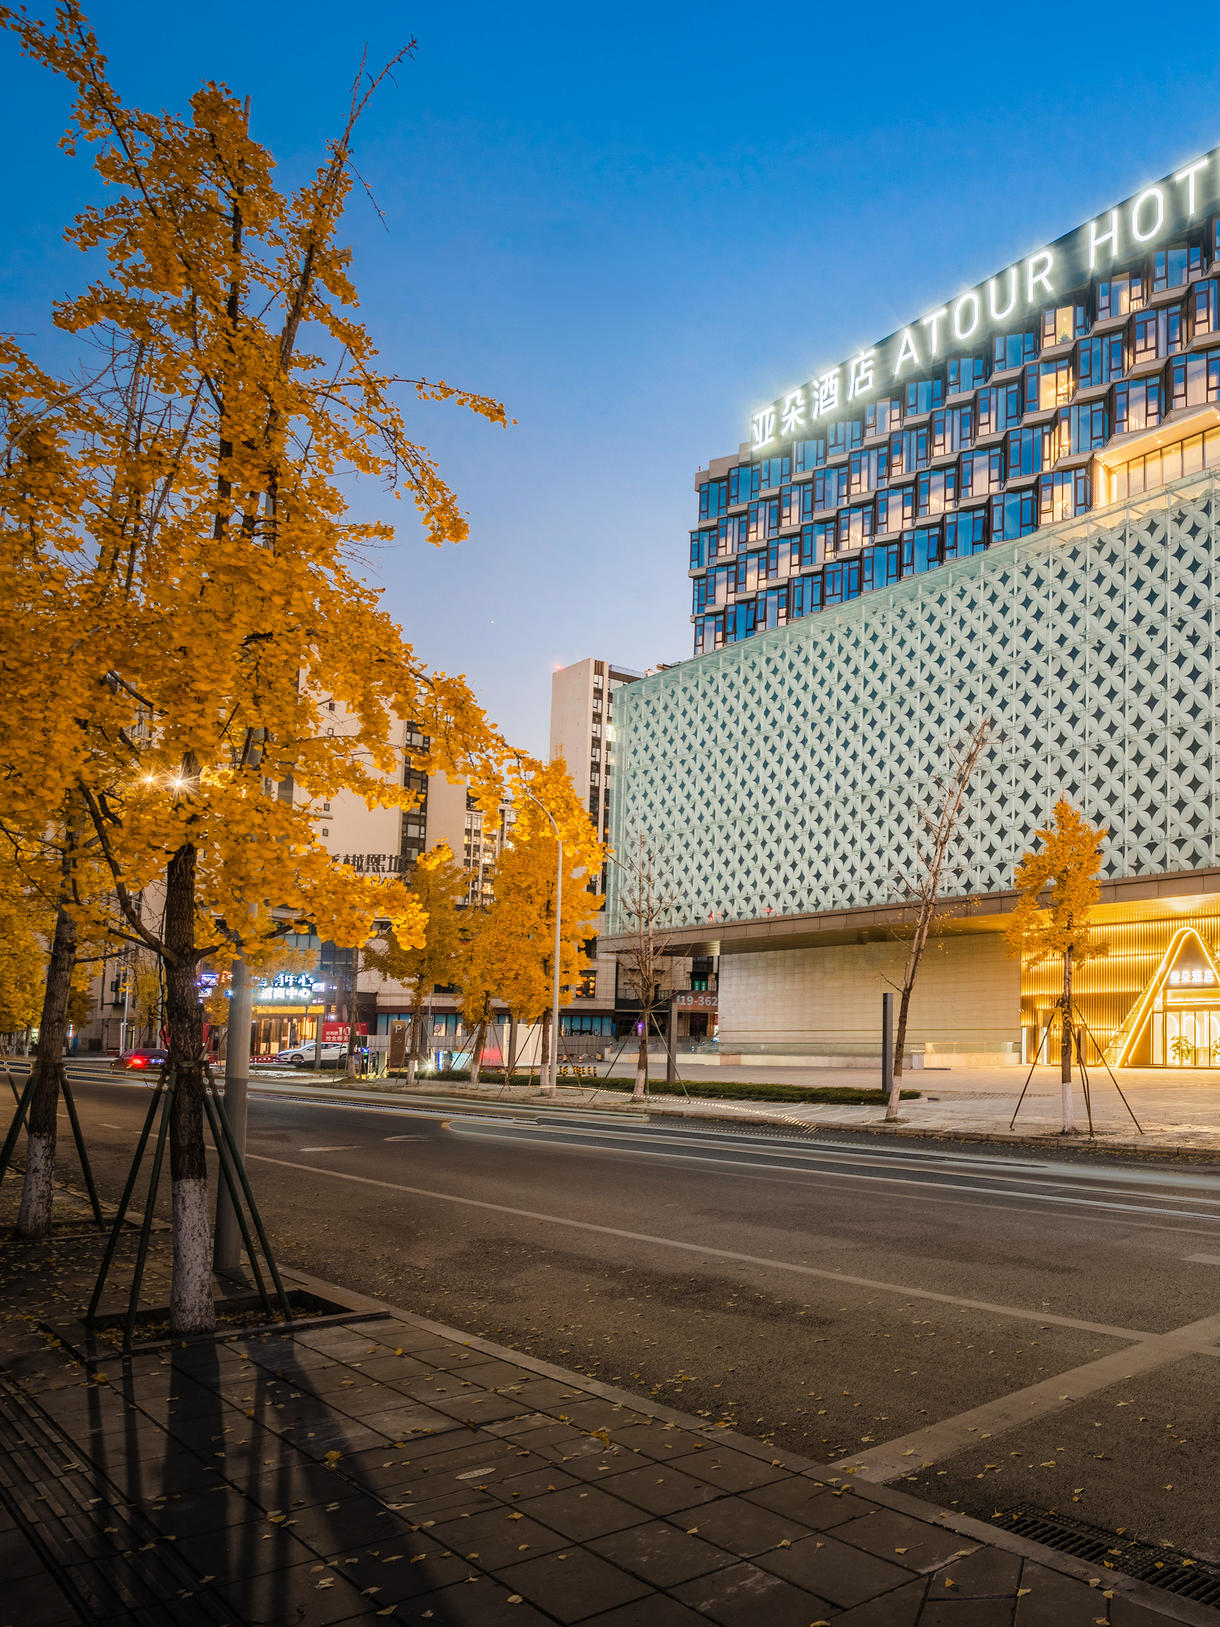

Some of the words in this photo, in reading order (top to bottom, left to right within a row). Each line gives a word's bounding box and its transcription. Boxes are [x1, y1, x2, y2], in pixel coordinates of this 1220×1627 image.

[752, 349, 875, 451] 亚朵酒店
[894, 251, 1055, 375] ATOUR
